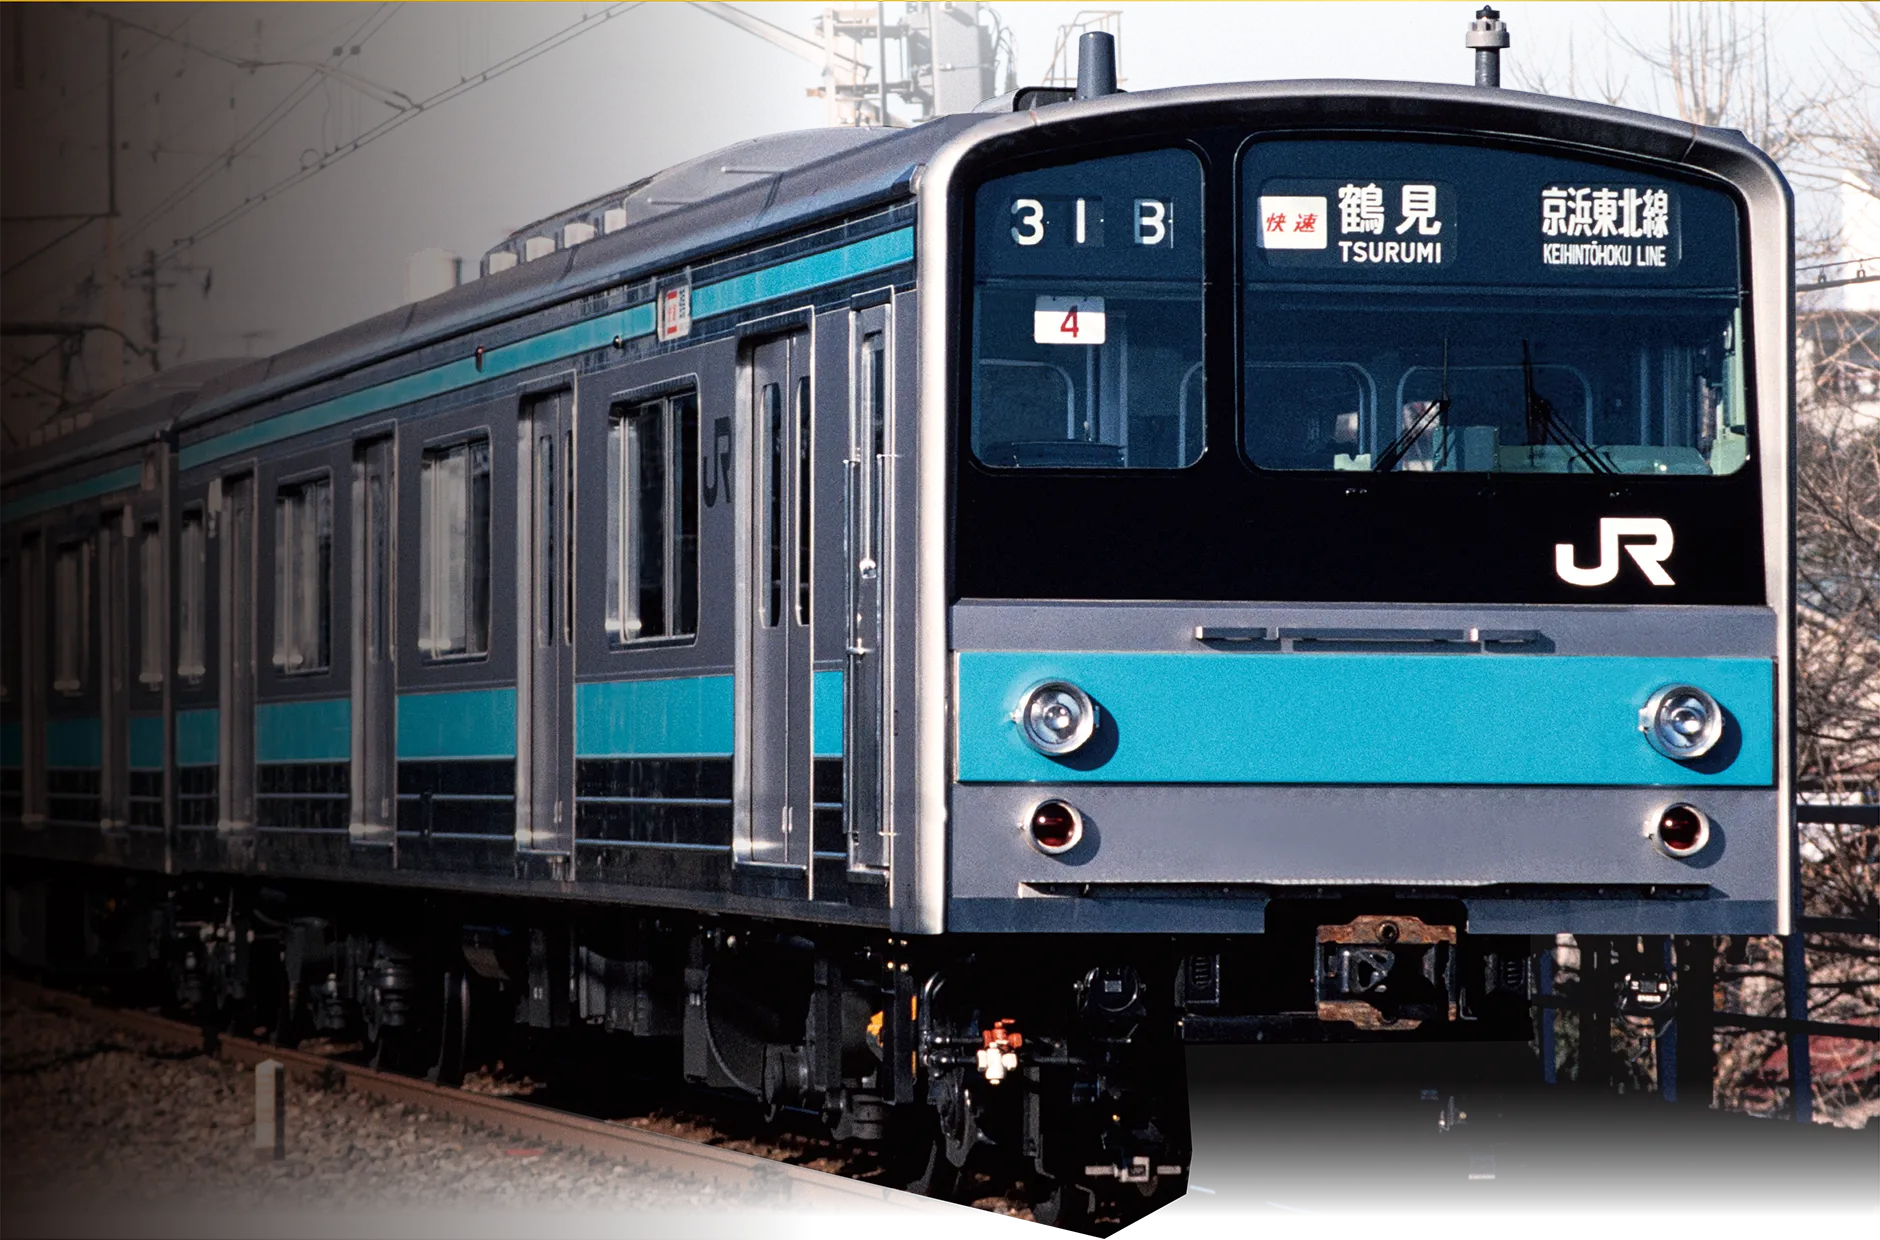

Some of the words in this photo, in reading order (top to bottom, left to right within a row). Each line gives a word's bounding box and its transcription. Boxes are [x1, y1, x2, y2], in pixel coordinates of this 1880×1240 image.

[1265, 213, 1318, 233] 快速
[1338, 183, 1442, 235] 鶴見
[1542, 187, 1669, 237] 京浜東北線
[1338, 241, 1442, 264] TSURUMI
[1636, 246, 1667, 267] LINE
[1060, 305, 1079, 338] 4
[703, 416, 731, 508] JR
[1555, 517, 1676, 587] JR
